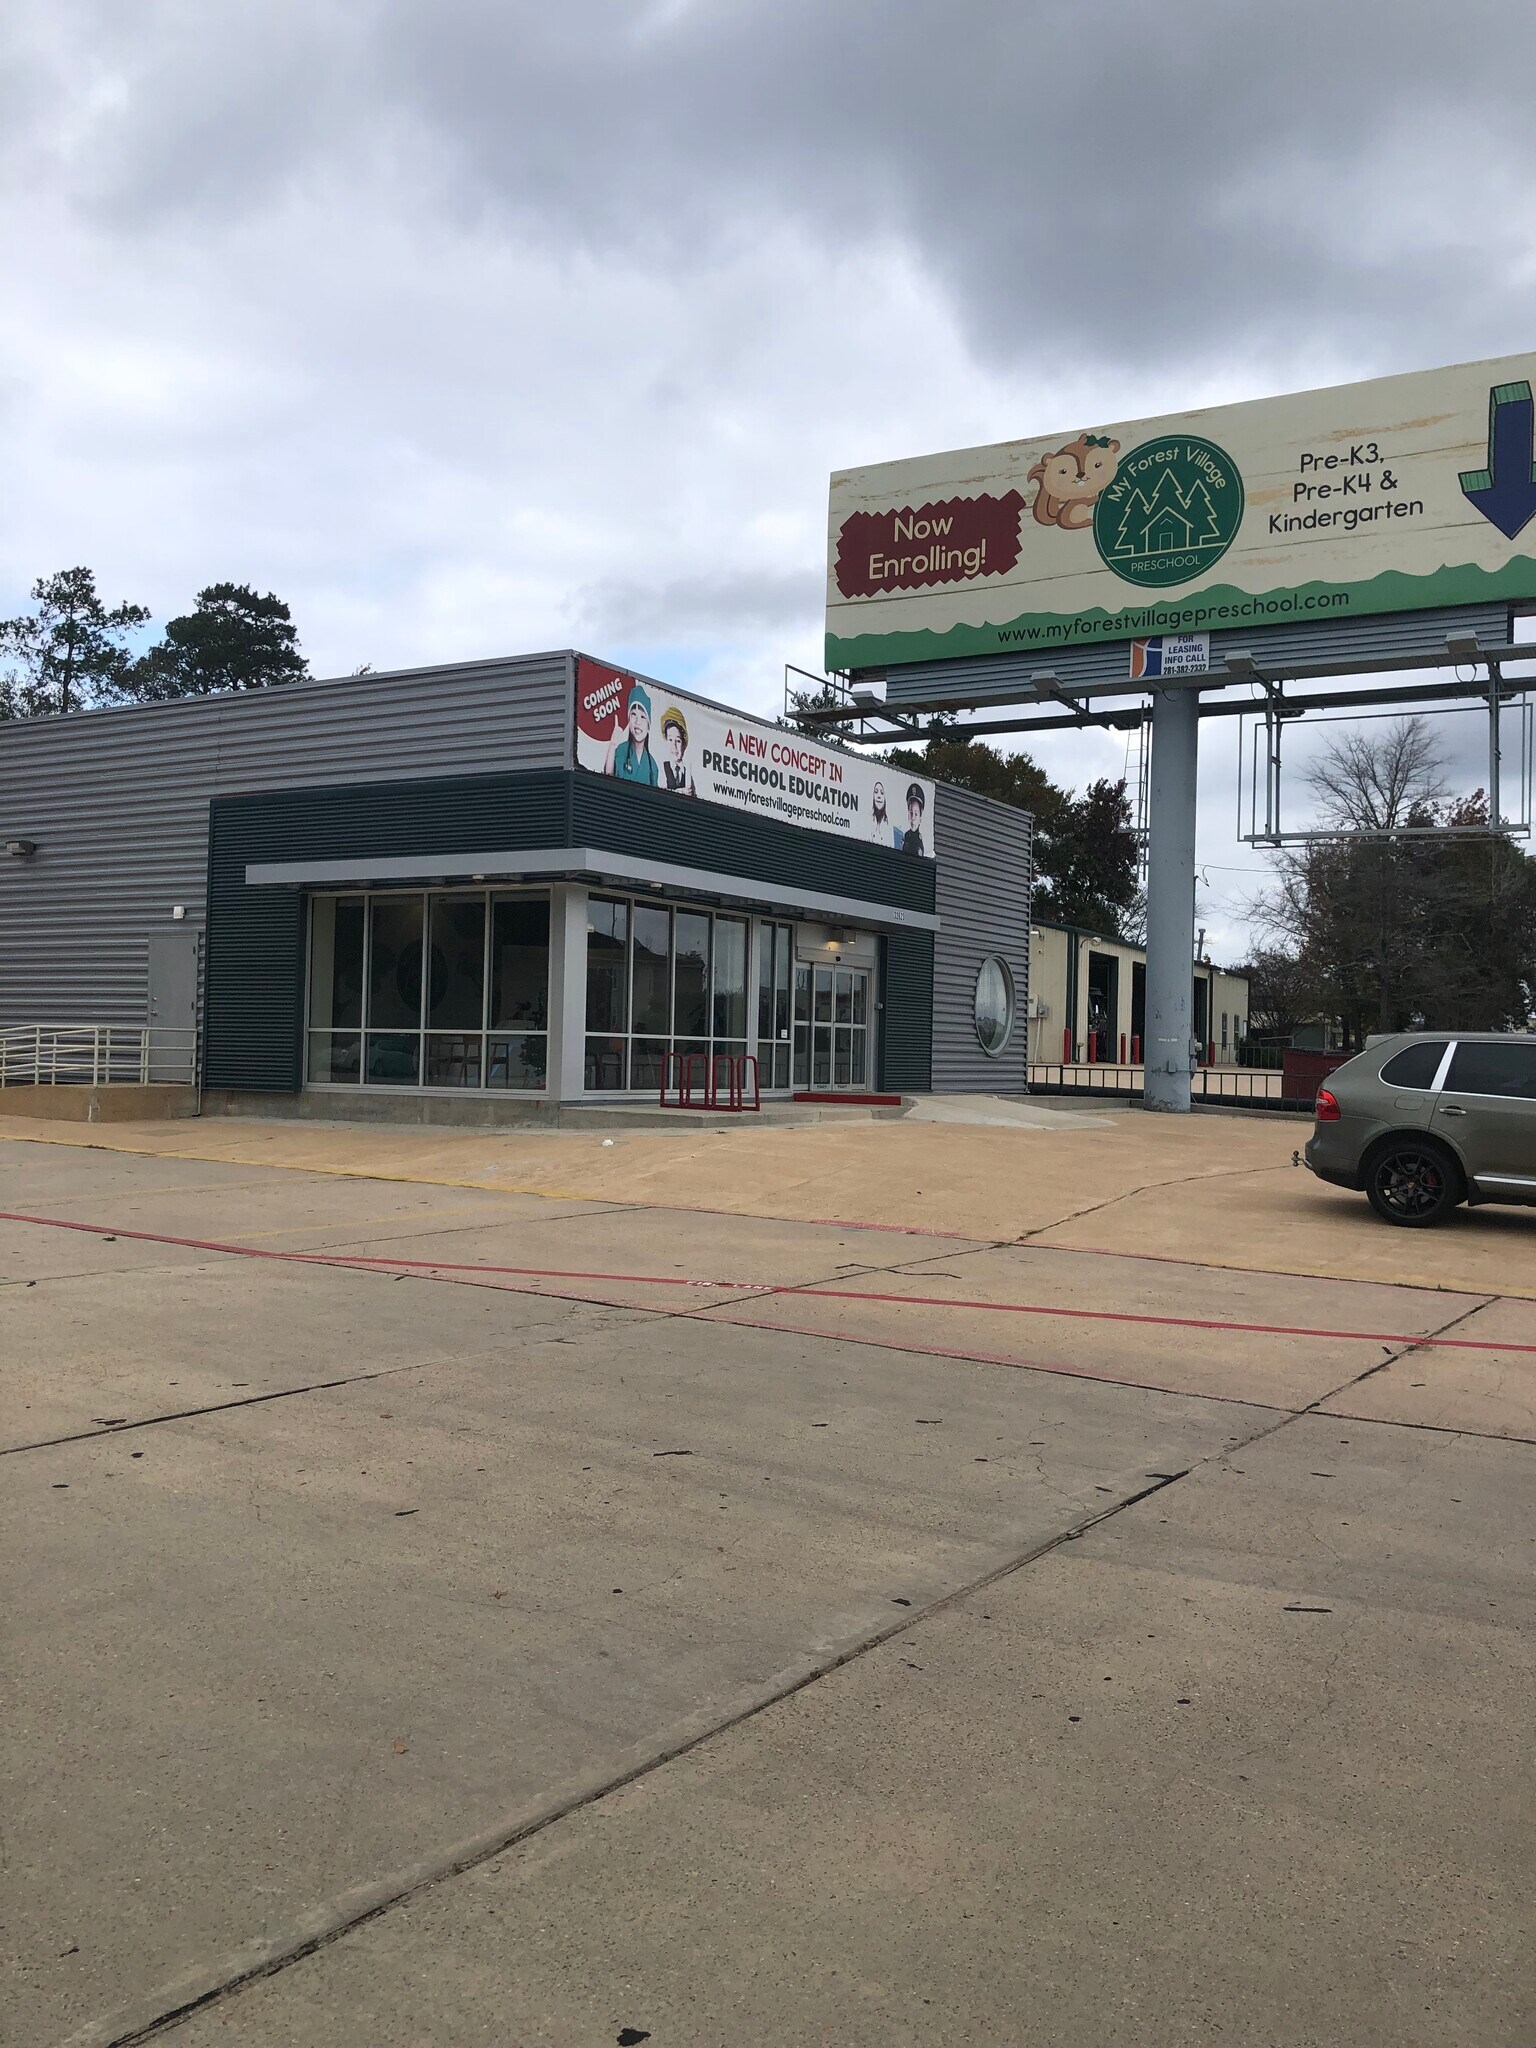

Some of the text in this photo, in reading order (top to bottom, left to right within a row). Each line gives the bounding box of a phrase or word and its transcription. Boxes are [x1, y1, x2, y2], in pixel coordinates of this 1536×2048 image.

[1107, 445, 1227, 502] My Forest Village
[1300, 443, 1385, 474] Pre-K3,
[1293, 469, 1398, 502] Pre-K4 &
[894, 515, 953, 543] Now
[1269, 500, 1424, 534] Kindergarten
[868, 538, 986, 580] Enrolling!
[1131, 555, 1201, 572] PRESCHOOL
[997, 589, 1350, 643] www.myforestvillagepreschool.com
[1168, 644, 1203, 654] LEASING
[1178, 635, 1194, 643] FOR
[1164, 654, 1206, 664] INFO CALL
[583, 677, 623, 710] COMING
[593, 695, 621, 722] SOON
[724, 728, 843, 783] A NEW CONCEPT IN
[702, 749, 859, 812] PRESCHOOL EDUCATION
[713, 782, 851, 829] www.myforestvillagepreschool.com
